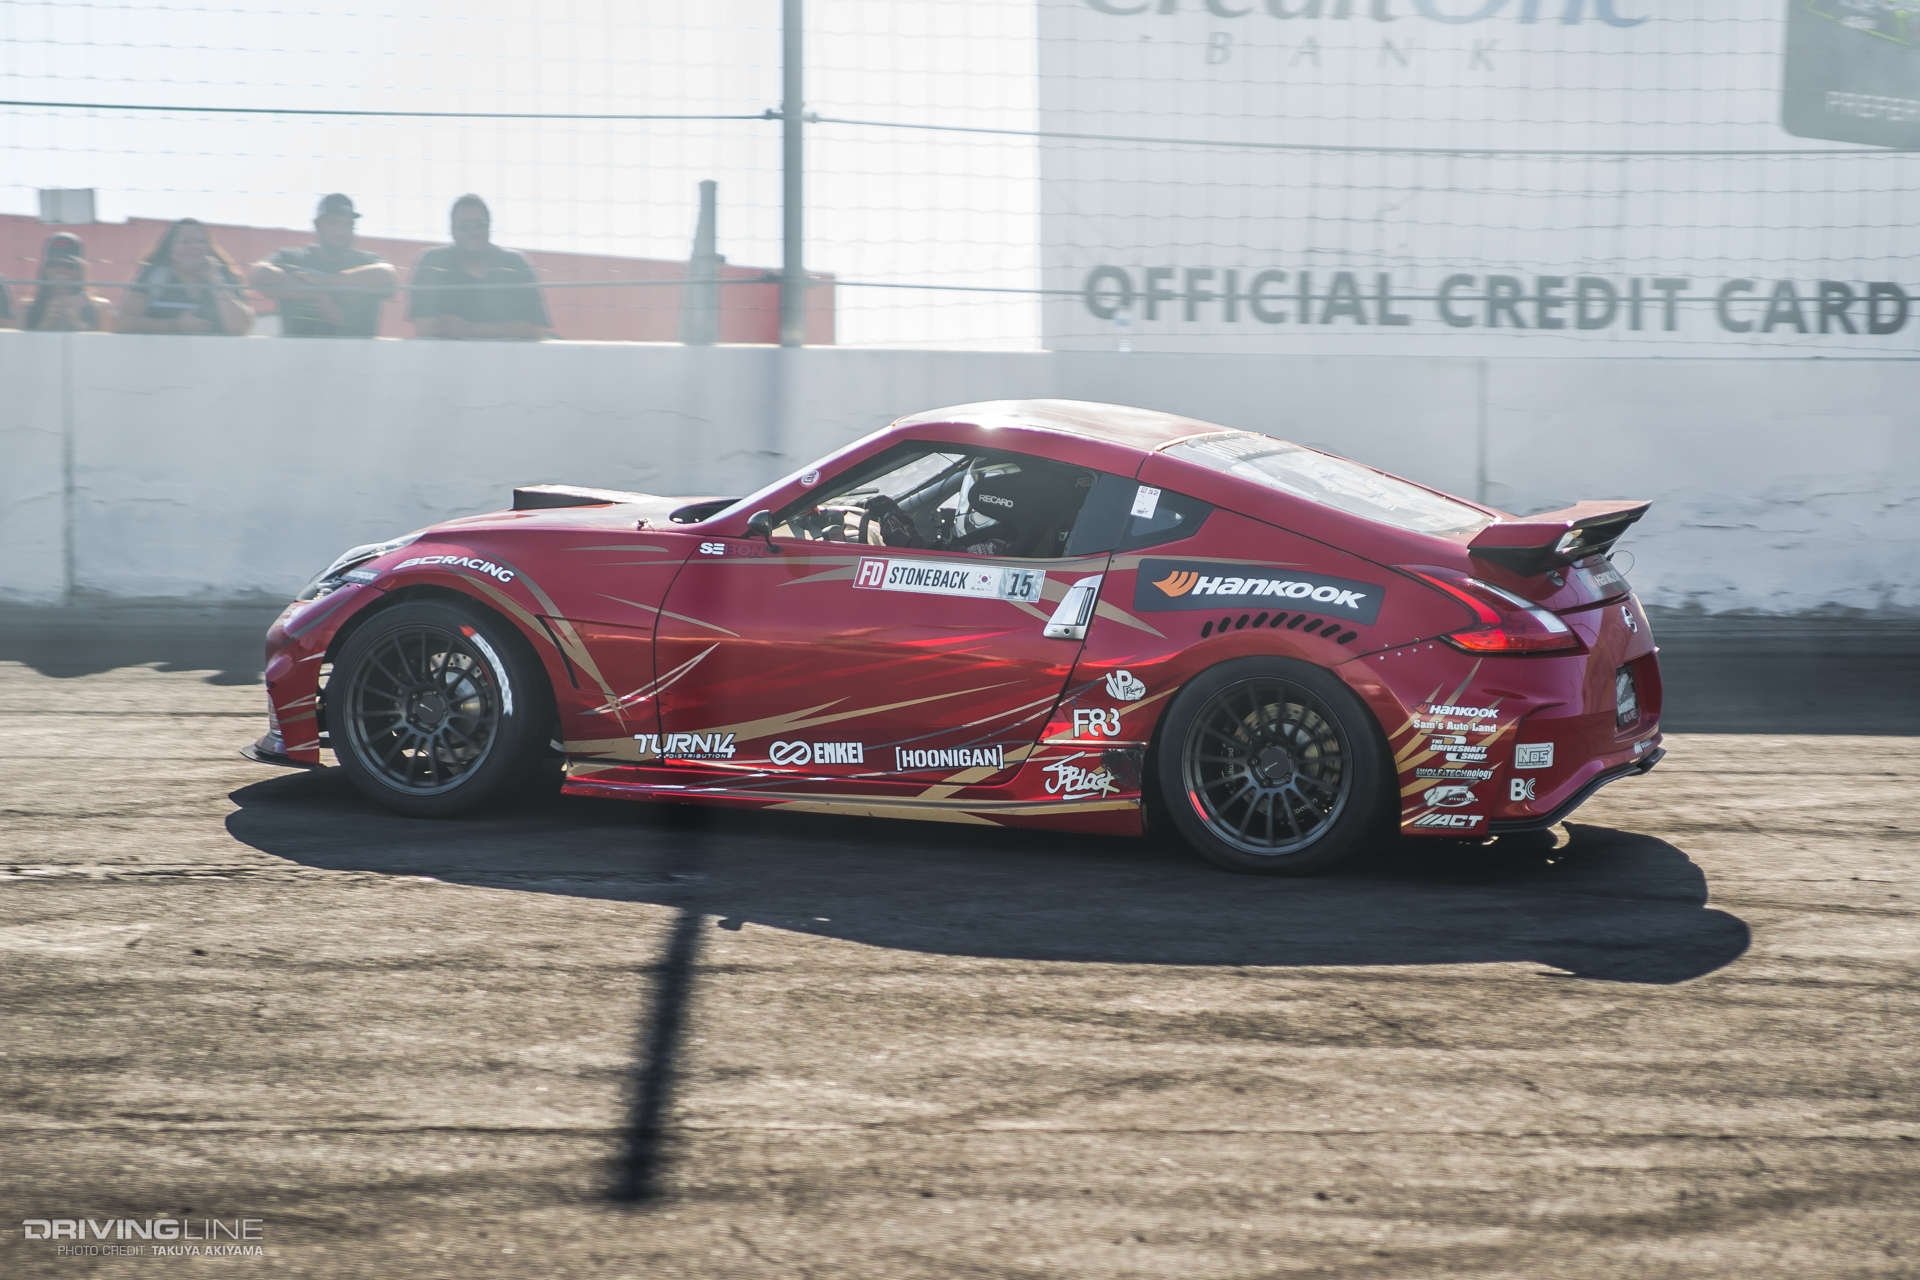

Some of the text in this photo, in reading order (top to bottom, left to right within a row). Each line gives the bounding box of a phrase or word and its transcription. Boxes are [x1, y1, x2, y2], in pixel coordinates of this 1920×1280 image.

[1083, 264, 1908, 335] OFFICIAL CREDIT CARD
[978, 493, 1013, 508] RECARO
[858, 560, 885, 587] FD
[889, 566, 970, 590] STONEBACK
[1007, 573, 1033, 598] 15
[1105, 670, 1133, 701] VP
[1413, 719, 1497, 733] Sam's Auto Land
[633, 733, 737, 759] TURN14
[813, 742, 864, 764] ENKEI
[1429, 743, 1488, 753] DRIVESHAFT
[1460, 752, 1488, 760] SHOP
[1510, 778, 1536, 801] BC
